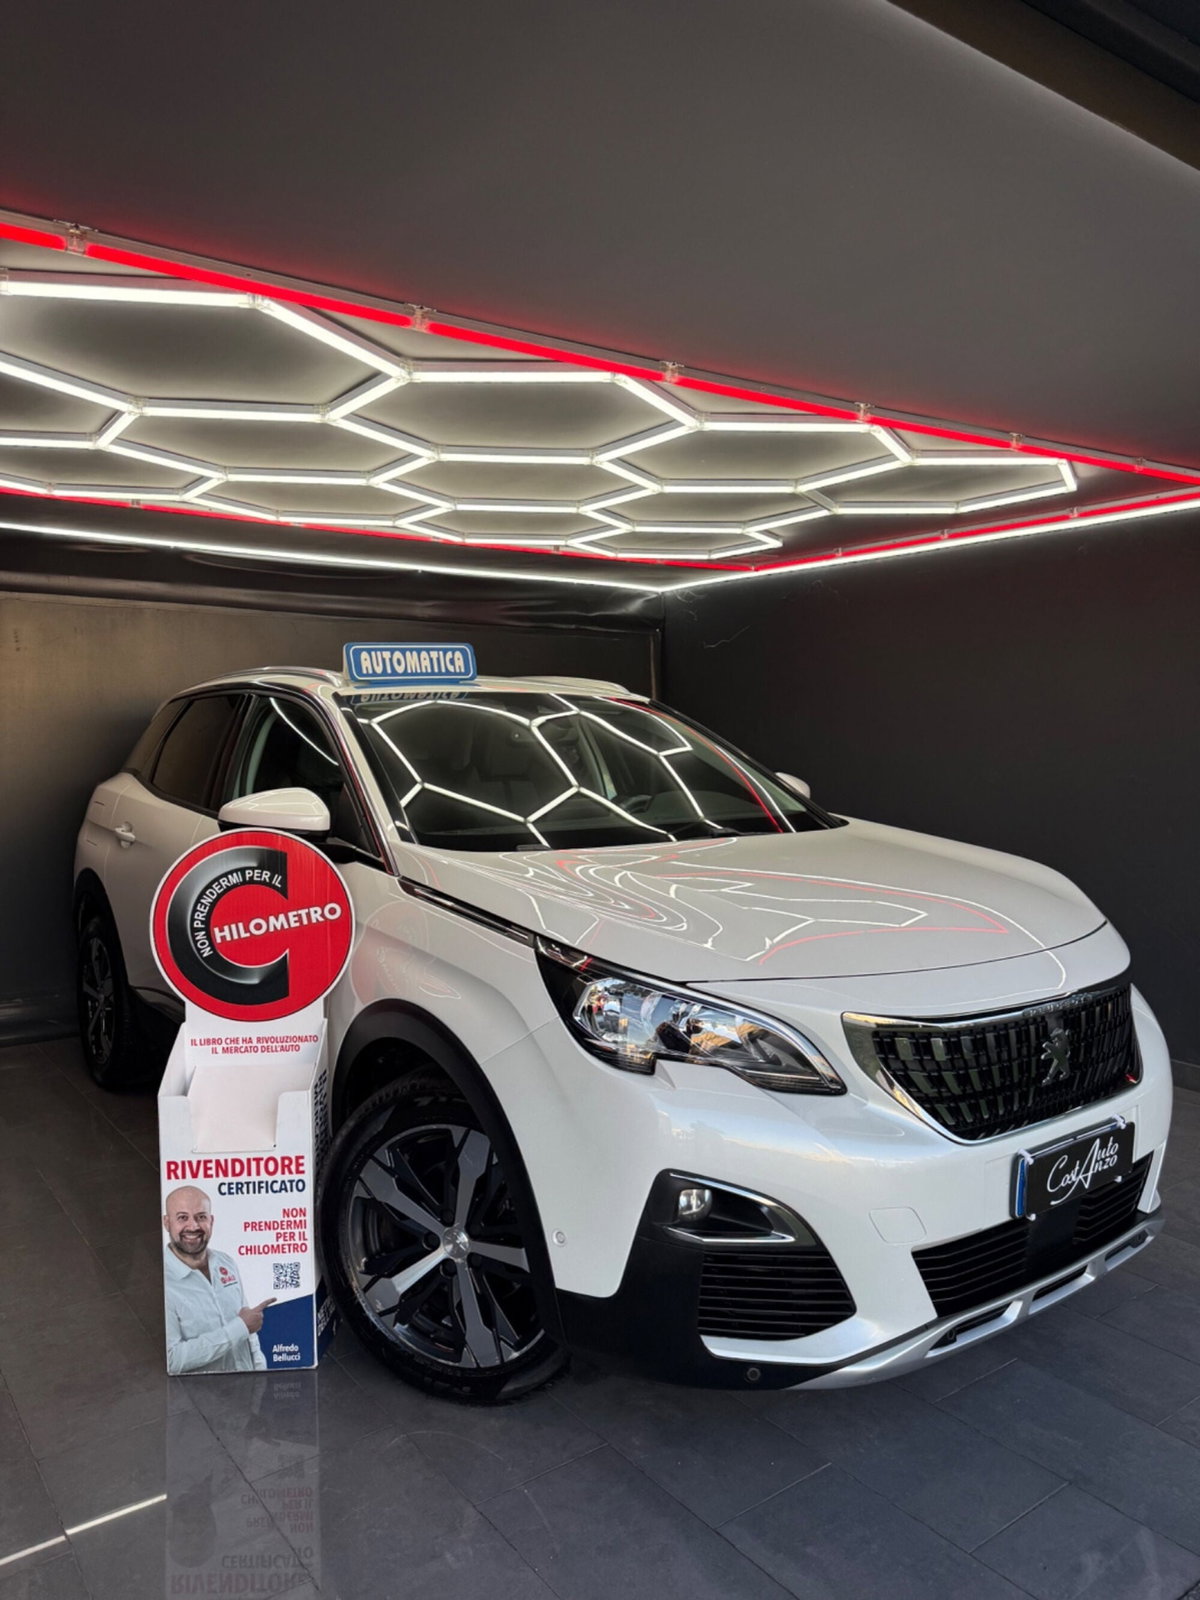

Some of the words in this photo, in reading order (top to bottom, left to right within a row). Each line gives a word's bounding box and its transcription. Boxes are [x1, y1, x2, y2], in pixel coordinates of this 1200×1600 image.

[360, 650, 465, 674] AUTOMATICA
[245, 869, 271, 883] PER
[272, 874, 283, 888] IL
[194, 871, 243, 928] PRENDERMI
[194, 931, 214, 958] NON
[190, 1038, 198, 1046] IL
[199, 1037, 223, 1046] LIBRO
[224, 1036, 239, 1045] CHE
[241, 1036, 253, 1044] HA
[256, 1034, 319, 1044] RIVOLUZIONATO
[221, 1045, 259, 1054] MERCATO
[260, 1044, 301, 1053] DELL'AUTO
[166, 1155, 306, 1180] RIVENDITORE
[217, 1179, 306, 1196] CERTIFICATO
[282, 1207, 307, 1218] NON
[243, 1219, 307, 1232] PRENDERMI
[275, 1231, 296, 1242] PER
[298, 1231, 308, 1241] IL
[238, 1242, 308, 1256] CHILOMETRO
[272, 1343, 299, 1352] Alfredo
[273, 1352, 301, 1362] Bellucci
